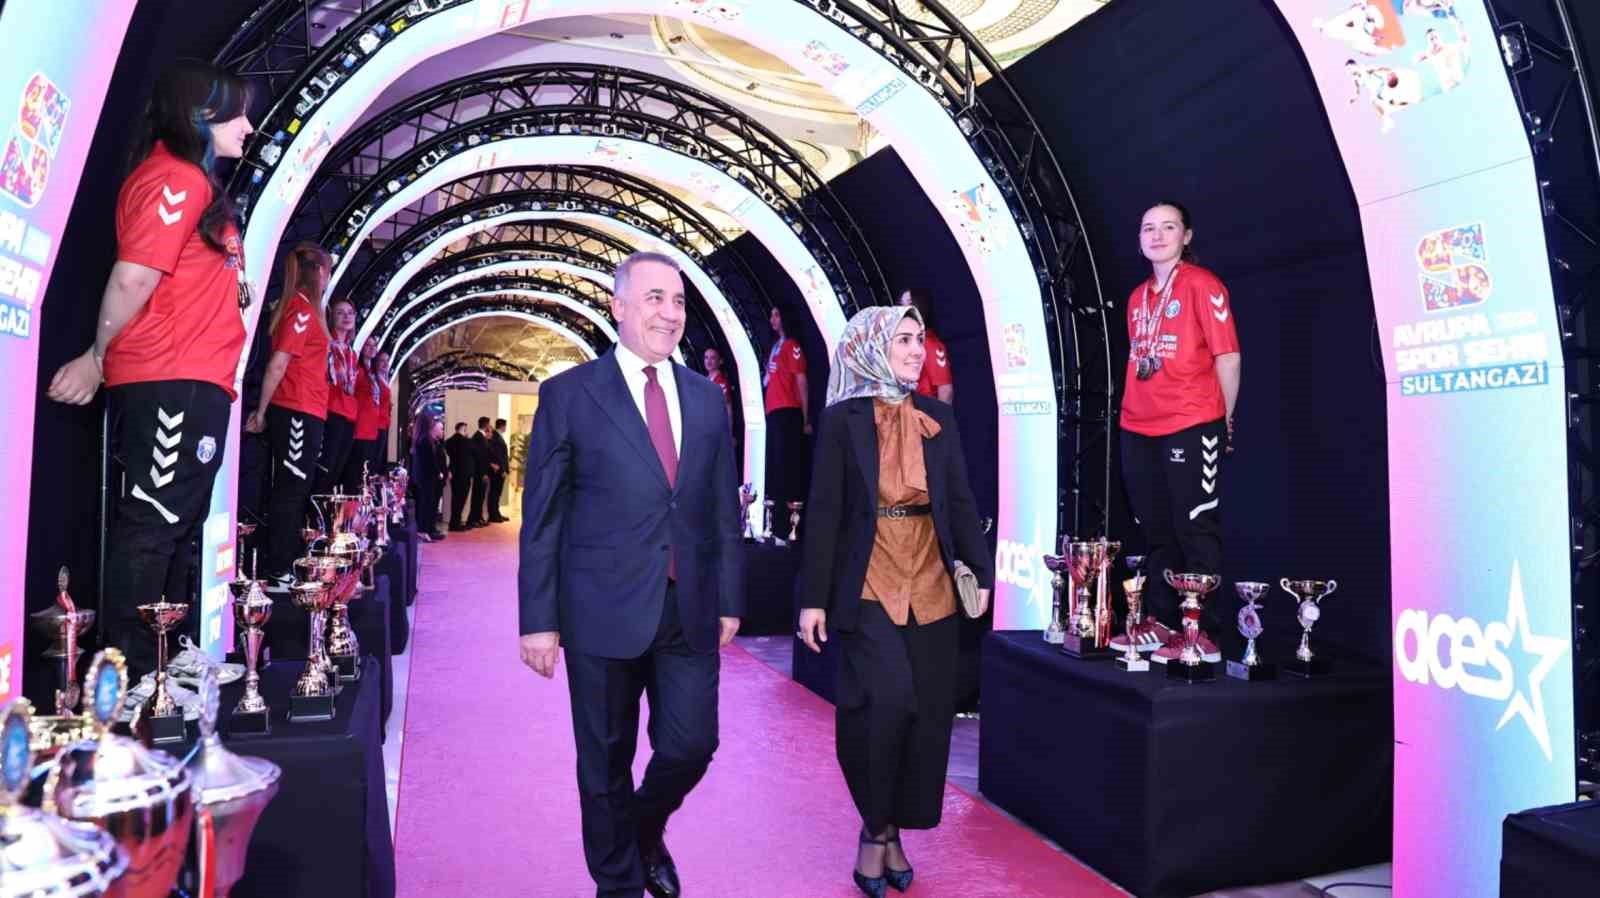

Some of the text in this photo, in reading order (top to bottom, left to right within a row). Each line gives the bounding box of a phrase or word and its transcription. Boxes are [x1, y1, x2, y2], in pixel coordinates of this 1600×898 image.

[1393, 313, 1491, 348] AVRUPA
[1395, 343, 1460, 372] SPOR
[1395, 608, 1514, 701] aces
